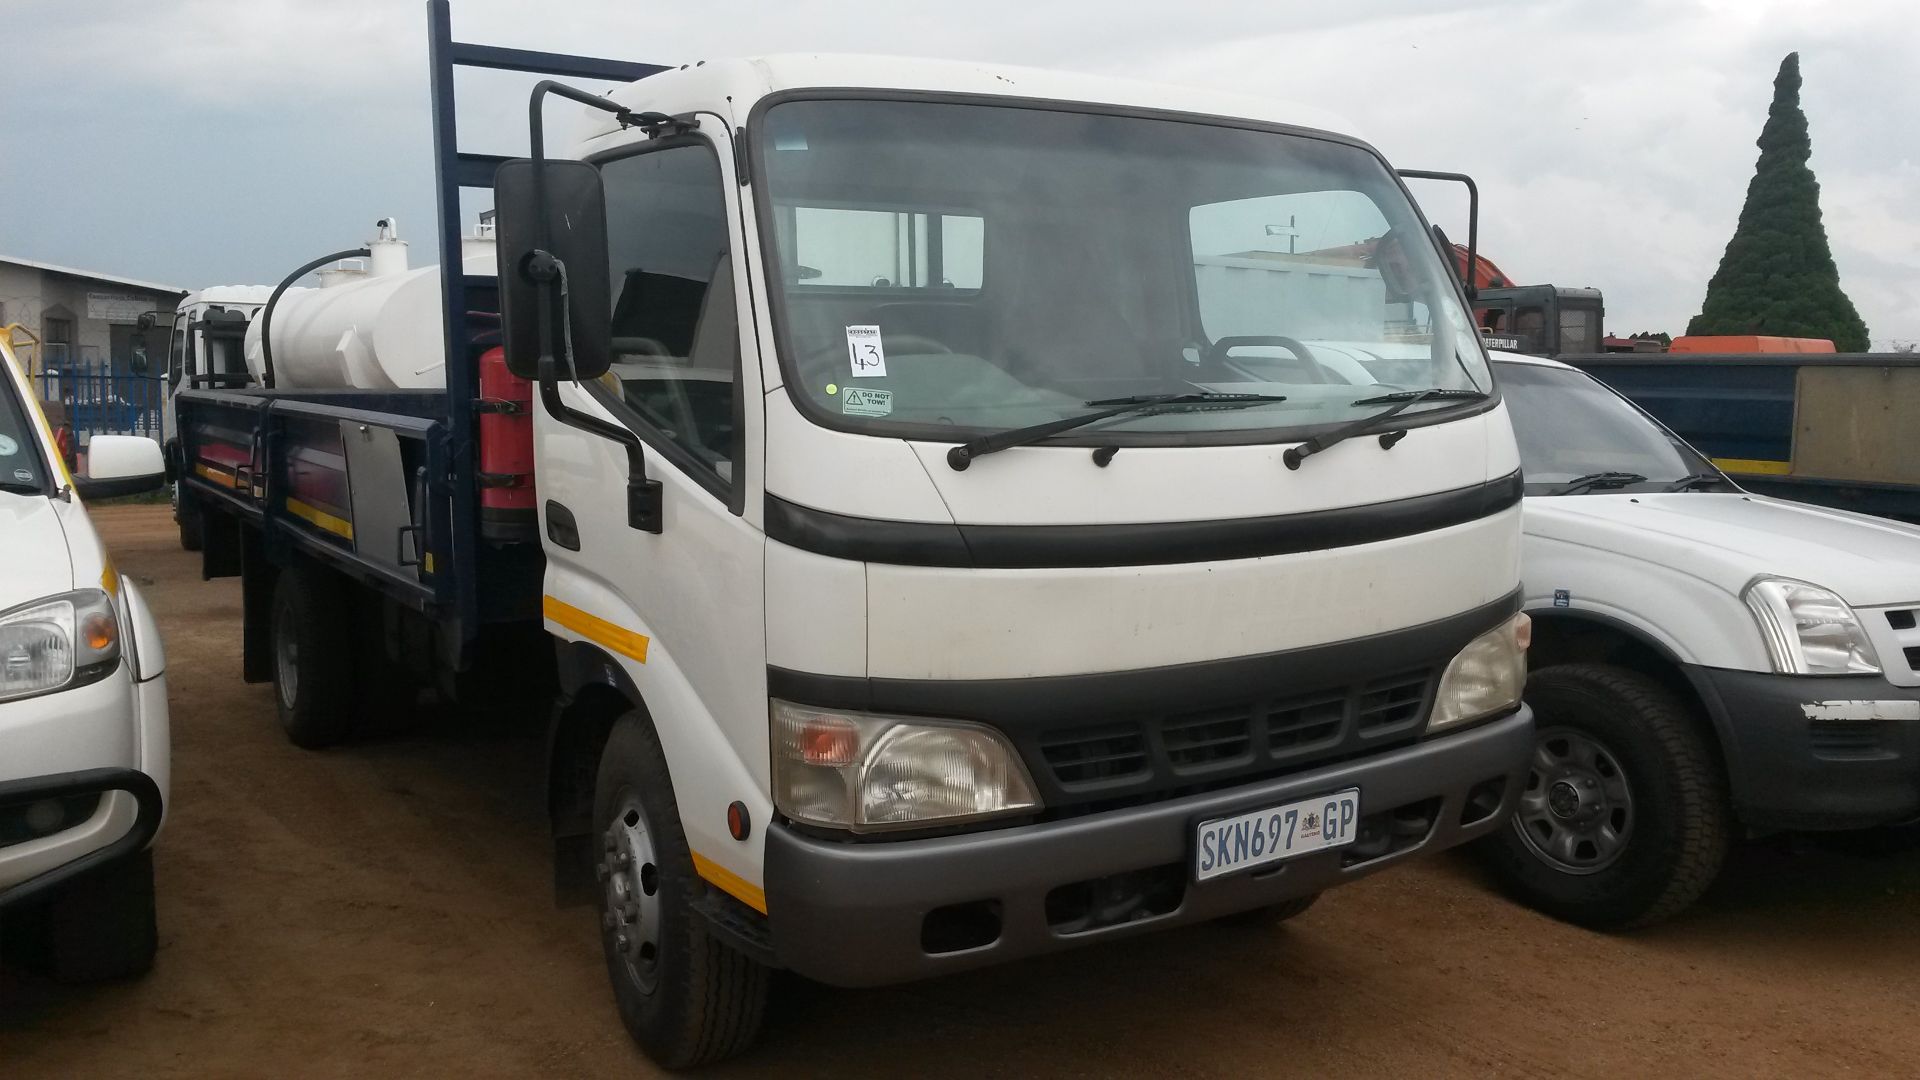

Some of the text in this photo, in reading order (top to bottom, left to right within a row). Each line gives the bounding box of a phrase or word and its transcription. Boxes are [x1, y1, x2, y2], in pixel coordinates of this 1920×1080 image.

[852, 343, 880, 370] 43
[1201, 799, 1354, 871] SKN697 GP
